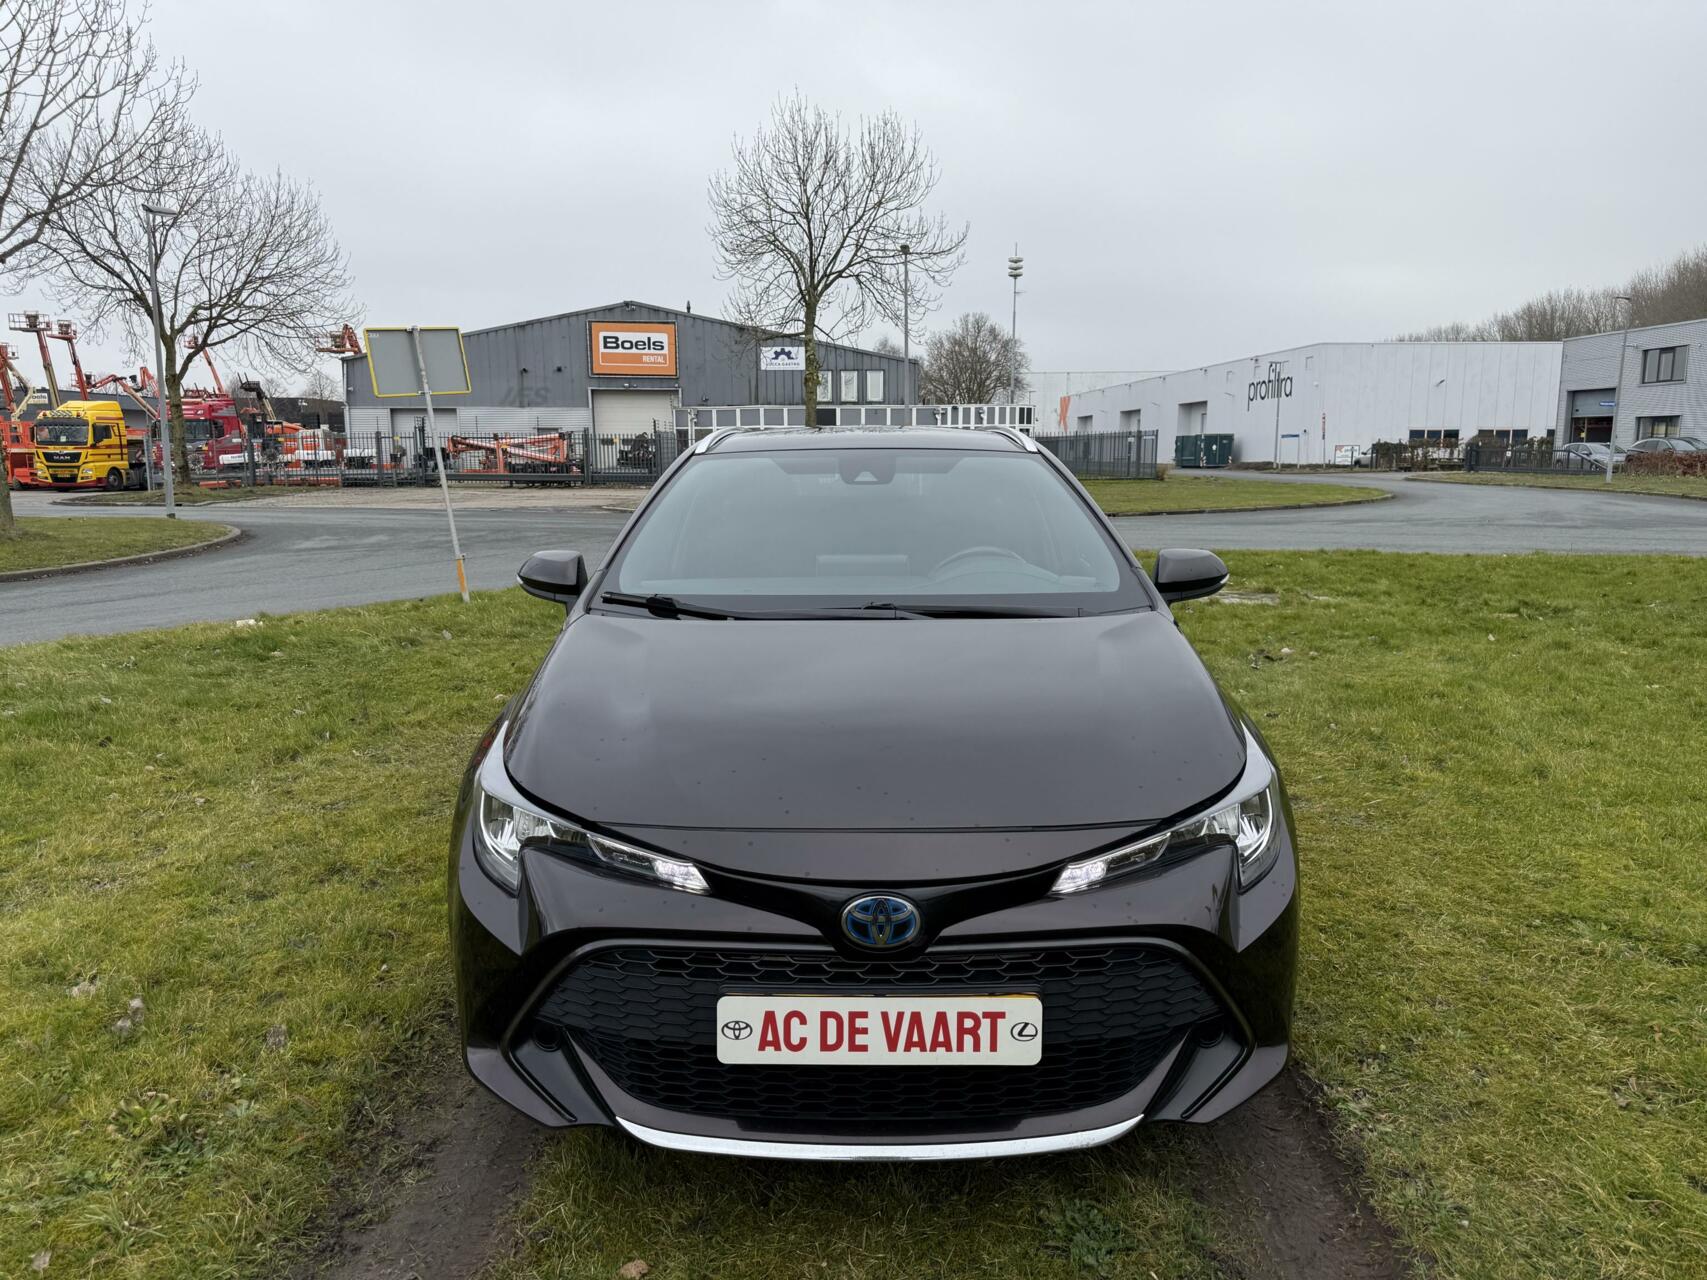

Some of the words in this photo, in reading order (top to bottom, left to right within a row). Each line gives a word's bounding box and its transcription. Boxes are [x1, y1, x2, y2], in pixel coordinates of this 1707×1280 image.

[603, 335, 665, 351] Boels
[642, 355, 666, 363] RENTAL
[1247, 363, 1293, 412] profiltra
[757, 1010, 808, 1052] AC
[819, 1011, 869, 1053] DE
[880, 1011, 1006, 1053] VAART
